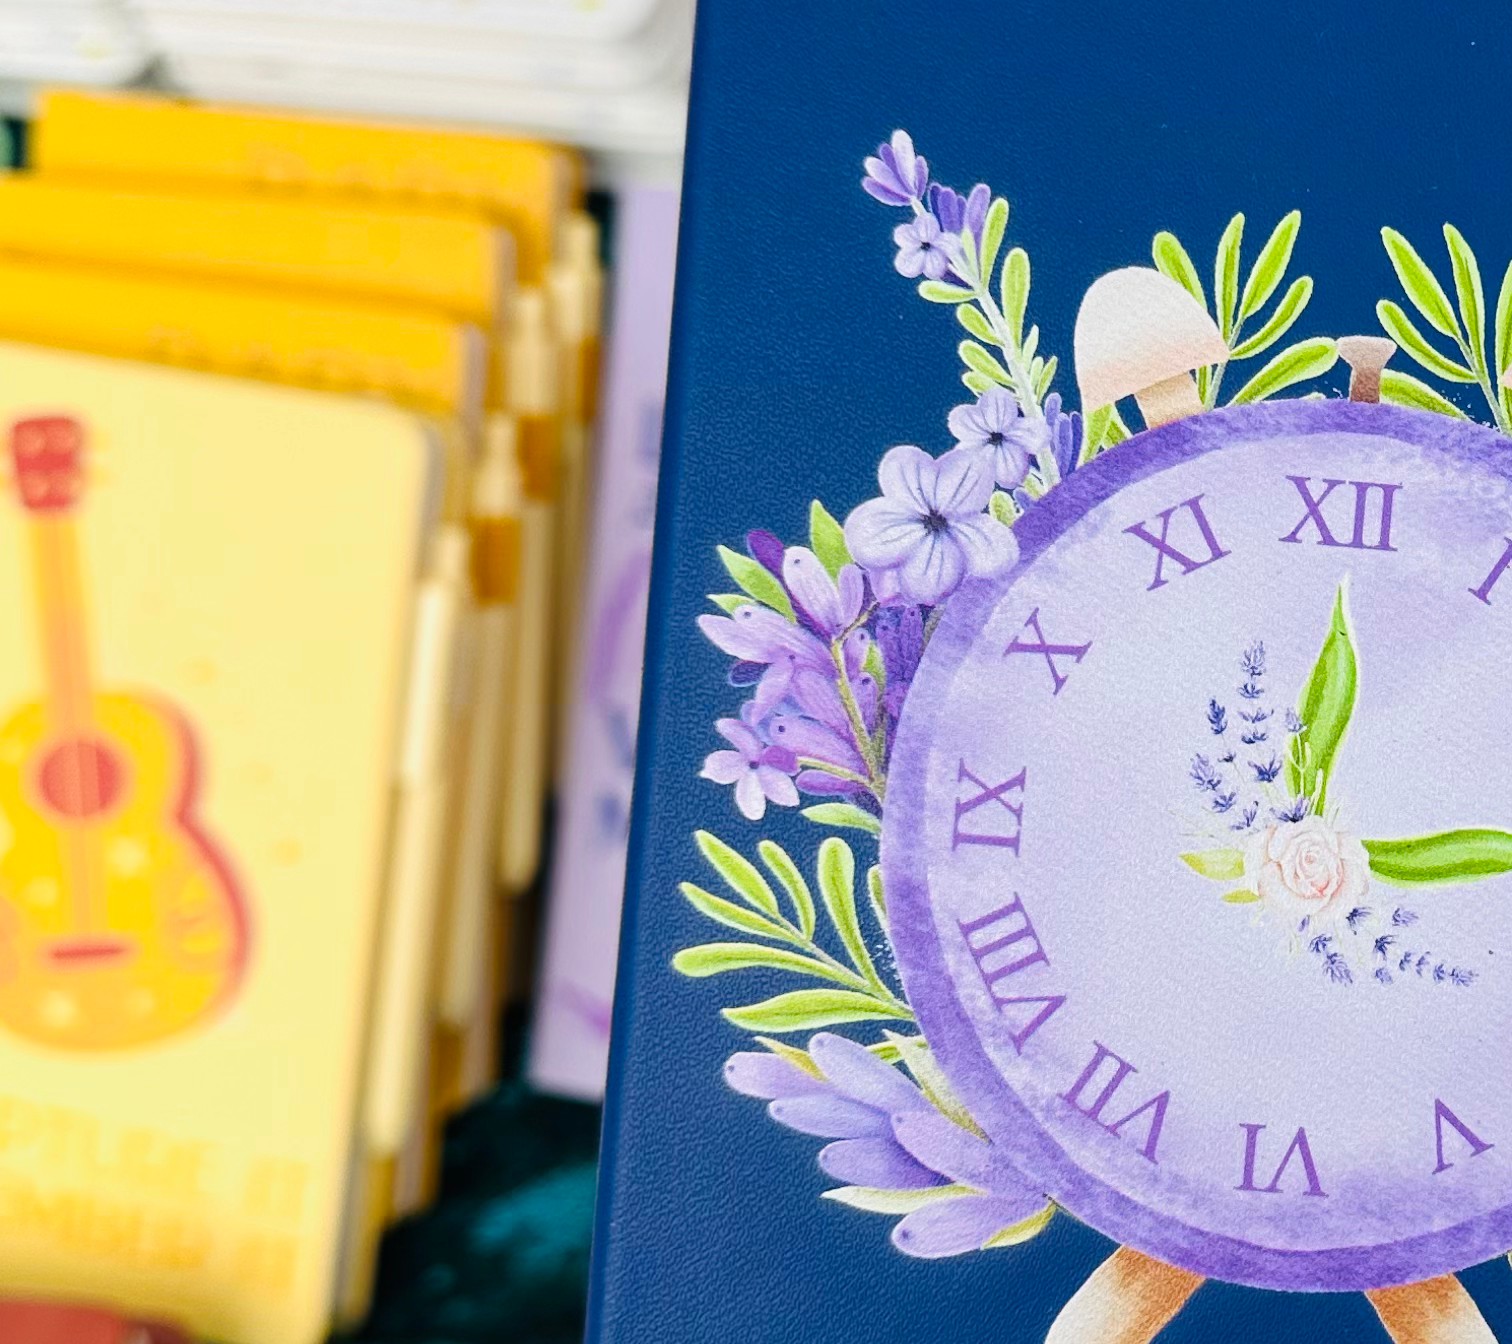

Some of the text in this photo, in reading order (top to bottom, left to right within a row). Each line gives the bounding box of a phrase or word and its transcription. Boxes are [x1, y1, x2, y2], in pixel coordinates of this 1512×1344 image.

[1123, 494, 1231, 590] XI
[1280, 475, 1402, 551] XII
[1003, 608, 1092, 695] X
[952, 758, 1028, 856] IX
[956, 892, 1067, 1053] VIII
[1056, 1040, 1172, 1164] VII
[1430, 1097, 1493, 1174] V
[1236, 1122, 1328, 1197] VI
